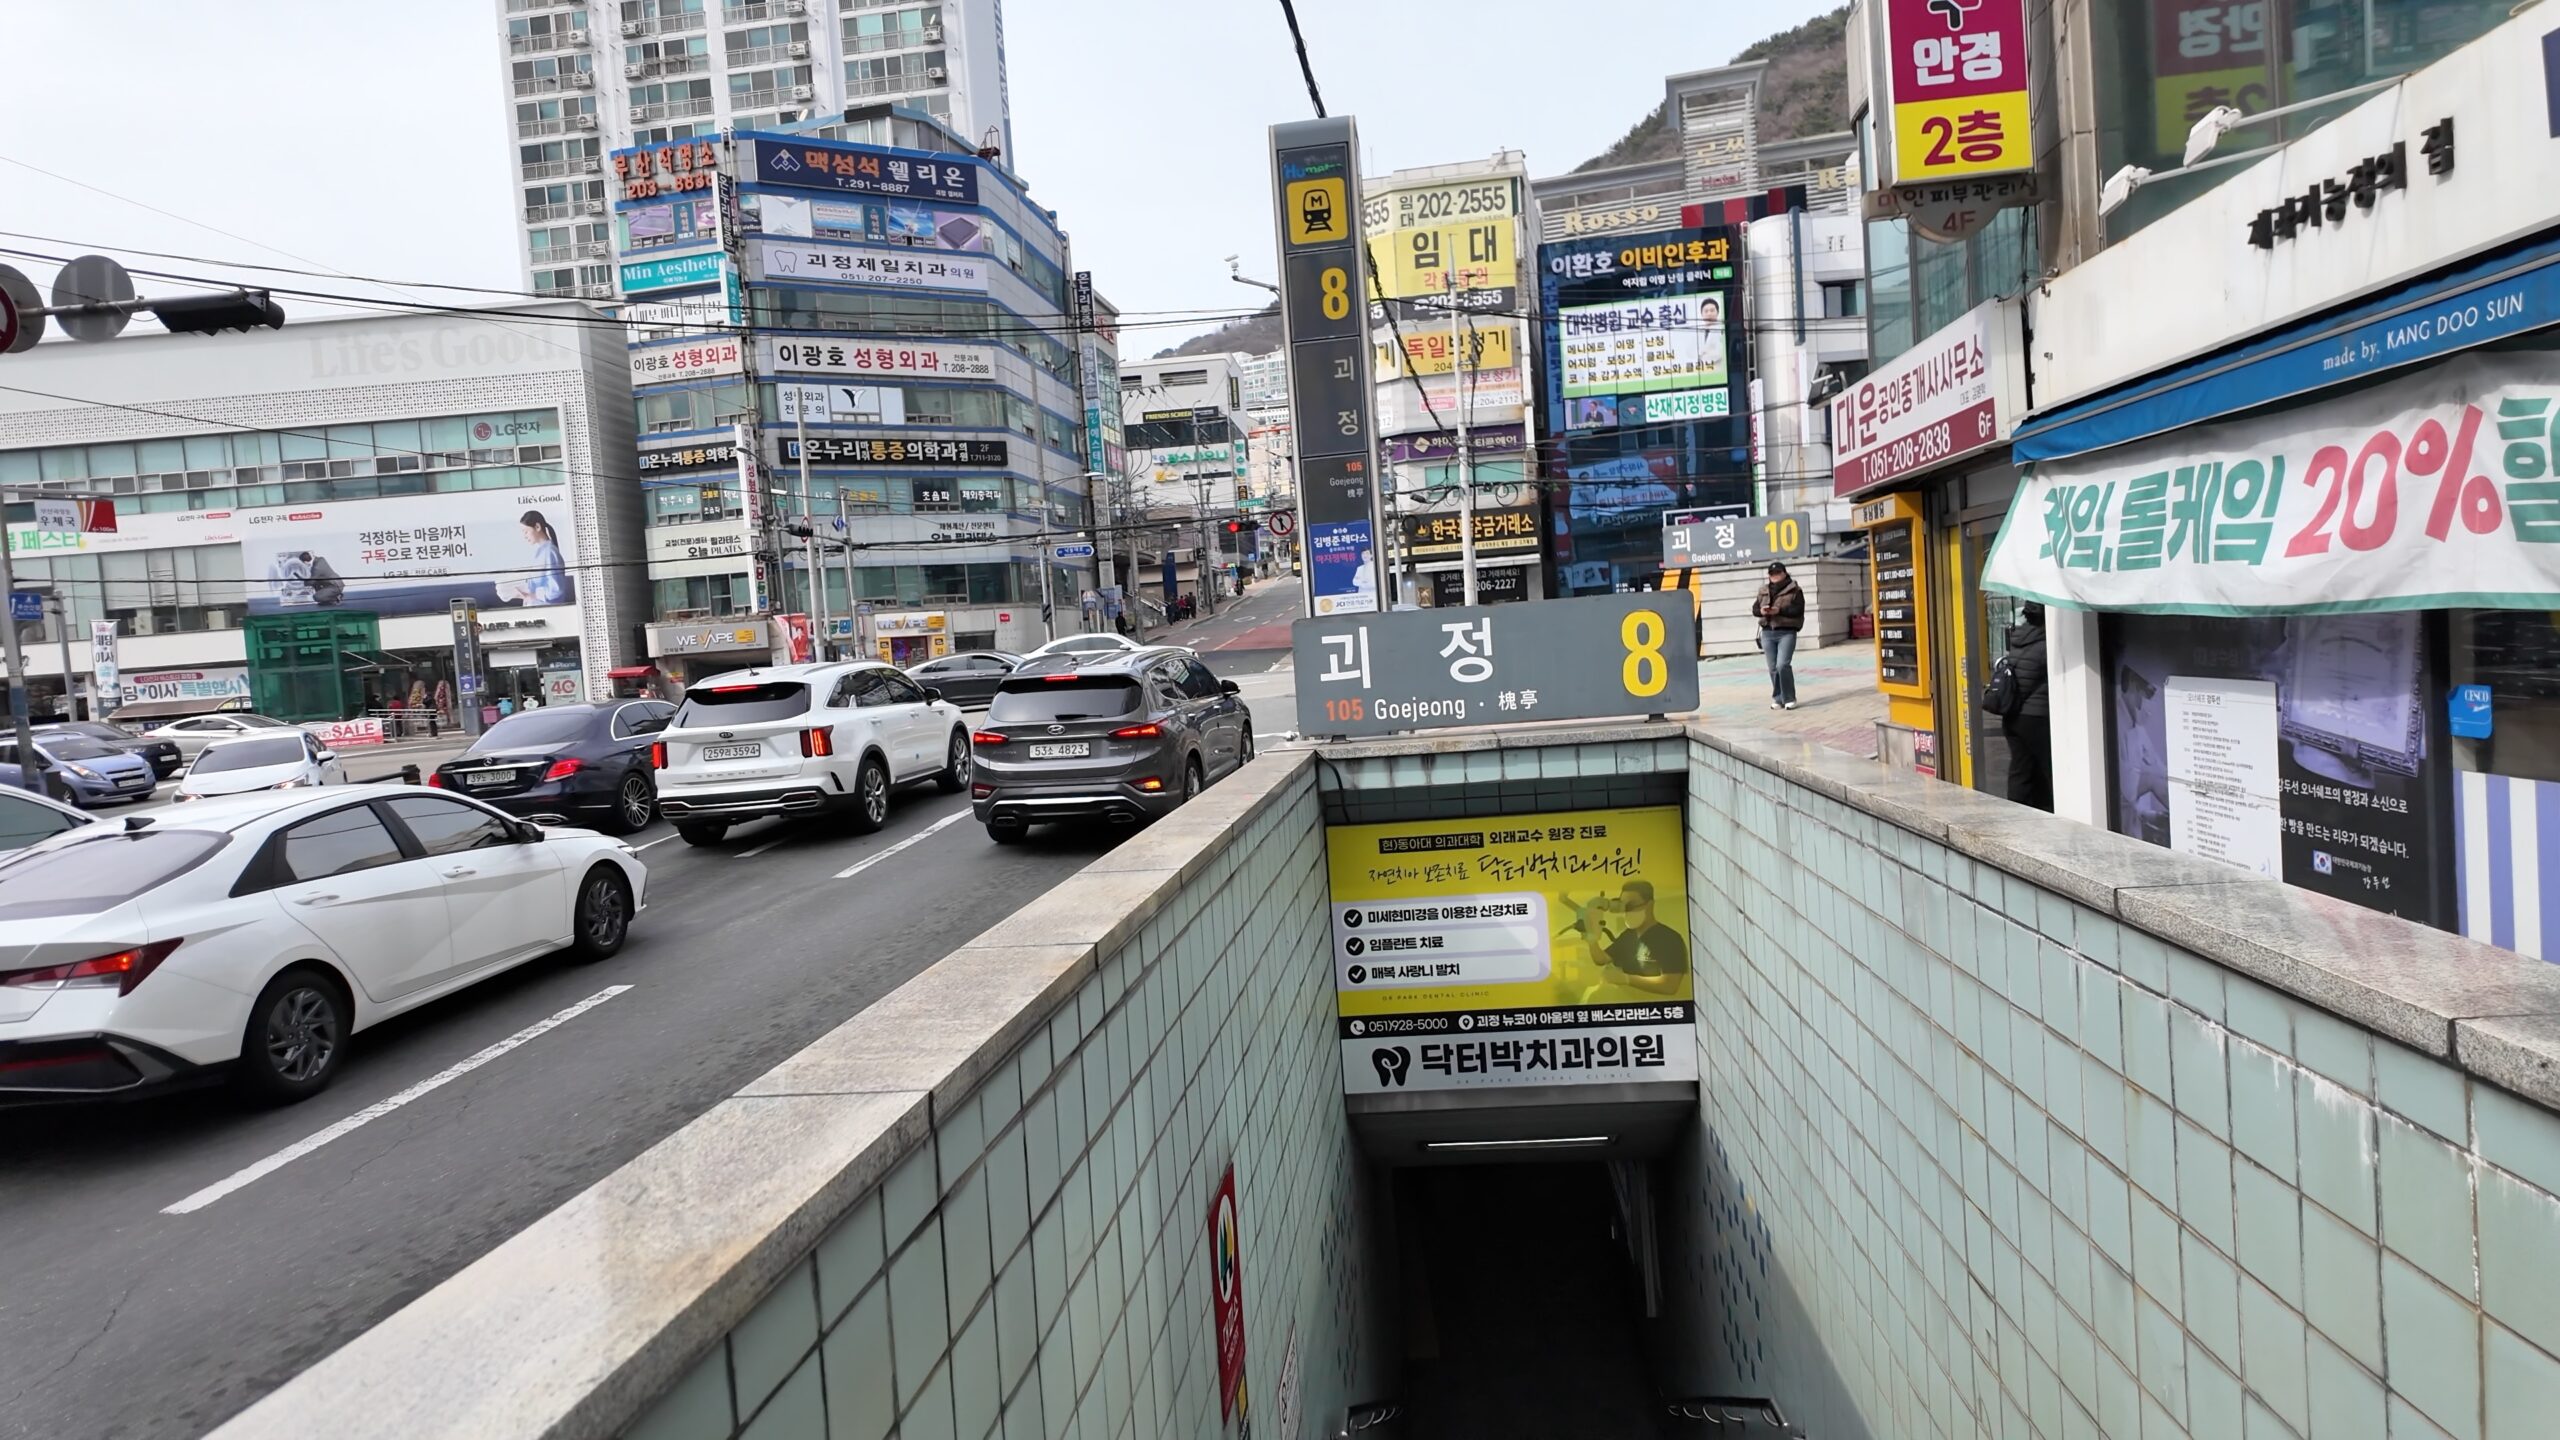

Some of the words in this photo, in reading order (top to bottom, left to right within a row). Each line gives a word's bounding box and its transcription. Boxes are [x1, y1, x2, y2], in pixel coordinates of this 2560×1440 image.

[1913, 31, 2003, 87] 안경
[1921, 110, 2005, 166] 2층
[2420, 117, 2455, 176] 집
[615, 142, 716, 180] 부산작명소
[835, 177, 910, 194] T.291-8887
[887, 159, 966, 188] 웰리온
[1400, 195, 1415, 228] 임대
[1418, 186, 1506, 219] 202-2555
[1563, 204, 1660, 236] Rosso
[1942, 210, 1977, 233] 4F
[1412, 225, 1498, 270] 임대
[1551, 250, 1616, 279] 이환호
[1620, 237, 1730, 272] 이비인후과
[624, 267, 651, 282] Min
[807, 253, 948, 277] 괴정제일치과
[950, 267, 975, 279] 의원
[1649, 274, 1666, 286] 이명
[1686, 269, 1711, 281] 클리닉
[868, 274, 923, 285] 207-2250
[1321, 266, 1349, 320] 8
[1566, 310, 1622, 337] 대학병원
[1626, 307, 1654, 331] 교수
[1659, 302, 1687, 330] 출신
[2323, 344, 2356, 371] made
[2361, 338, 2381, 361] by.
[2386, 320, 2431, 351] KANG
[2437, 306, 2479, 337] DOO
[2486, 292, 2524, 322] SUN
[1616, 338, 1635, 350] 이명
[1645, 335, 1665, 347] 난청
[634, 355, 669, 372] 이광호
[672, 345, 738, 369] 성형외과
[779, 344, 847, 368] 이광호
[854, 348, 940, 371] 성형외과
[943, 363, 990, 374] T.208-2888
[1568, 356, 1597, 370] 어지럼
[1646, 349, 1675, 362] 클리닉
[1685, 359, 1715, 373] 클리닉
[1479, 395, 1519, 406] 204-2112
[1647, 390, 1728, 419] 산재지정병원
[495, 421, 541, 437] LG전자
[1978, 410, 1993, 439] 6F
[1860, 421, 1952, 485] T.051-208-2838
[1346, 461, 1363, 472] 105
[1330, 476, 1364, 487] Goejeong
[2284, 403, 2503, 558] 20%
[922, 490, 950, 501] 초음파
[41, 516, 76, 527] 우체국
[359, 531, 411, 546] 걱정하는
[414, 525, 466, 543] 마음까지
[711, 535, 742, 546] 필라테스
[1765, 518, 1799, 554] 10
[361, 547, 413, 564] 구독으로
[416, 543, 473, 560] 전문케어.
[688, 547, 708, 557] 오늘
[711, 545, 743, 555] PILATES
[1691, 551, 1726, 564] Goejeong
[1476, 578, 1517, 592] 206-2227
[877, 620, 896, 630] WE
[896, 616, 927, 630] VAPE
[677, 634, 697, 646] WE
[697, 629, 734, 649] VAPE
[1621, 608, 1669, 698] 8
[1326, 698, 1365, 722] 105
[1374, 696, 1467, 724] Goejeong
[1498, 689, 1539, 712] 槐亭
[331, 721, 375, 738] SALE
[1058, 744, 1084, 755] 4823
[2342, 788, 2369, 809] 열정과
[2371, 794, 2409, 814] 소신으로
[1434, 834, 1482, 850] 의과대학
[1489, 829, 1544, 846] 외래교수
[1548, 827, 1576, 842] 원장
[1579, 825, 1608, 840] 진료
[2288, 818, 2305, 836] 빵을
[2306, 822, 2332, 842] 만드는
[2332, 828, 2359, 848] 리우가
[2360, 834, 2410, 859] 되겠습니다.
[1368, 907, 1440, 924] 미세현미경을
[1441, 906, 1478, 920] 이용한
[1480, 903, 1529, 919] 신경치료
[1370, 937, 1418, 952] 임플란트
[1419, 935, 1444, 950] 치료
[1372, 966, 1396, 980] 매복
[1398, 964, 1434, 979] 사랑니
[1436, 963, 1460, 977] 발치
[1368, 1018, 1448, 1033] 051)928-5000
[1476, 1014, 1500, 1028] 괴정
[1502, 1013, 1538, 1027] 뉴코아
[1540, 1011, 1575, 1024] 아울렛
[1576, 1010, 1590, 1023] 옆
[1591, 1006, 1663, 1023] 베스킨라빈스
[1663, 1006, 1685, 1020] 5층
[1420, 1034, 1666, 1076] 닥터박치과의원
